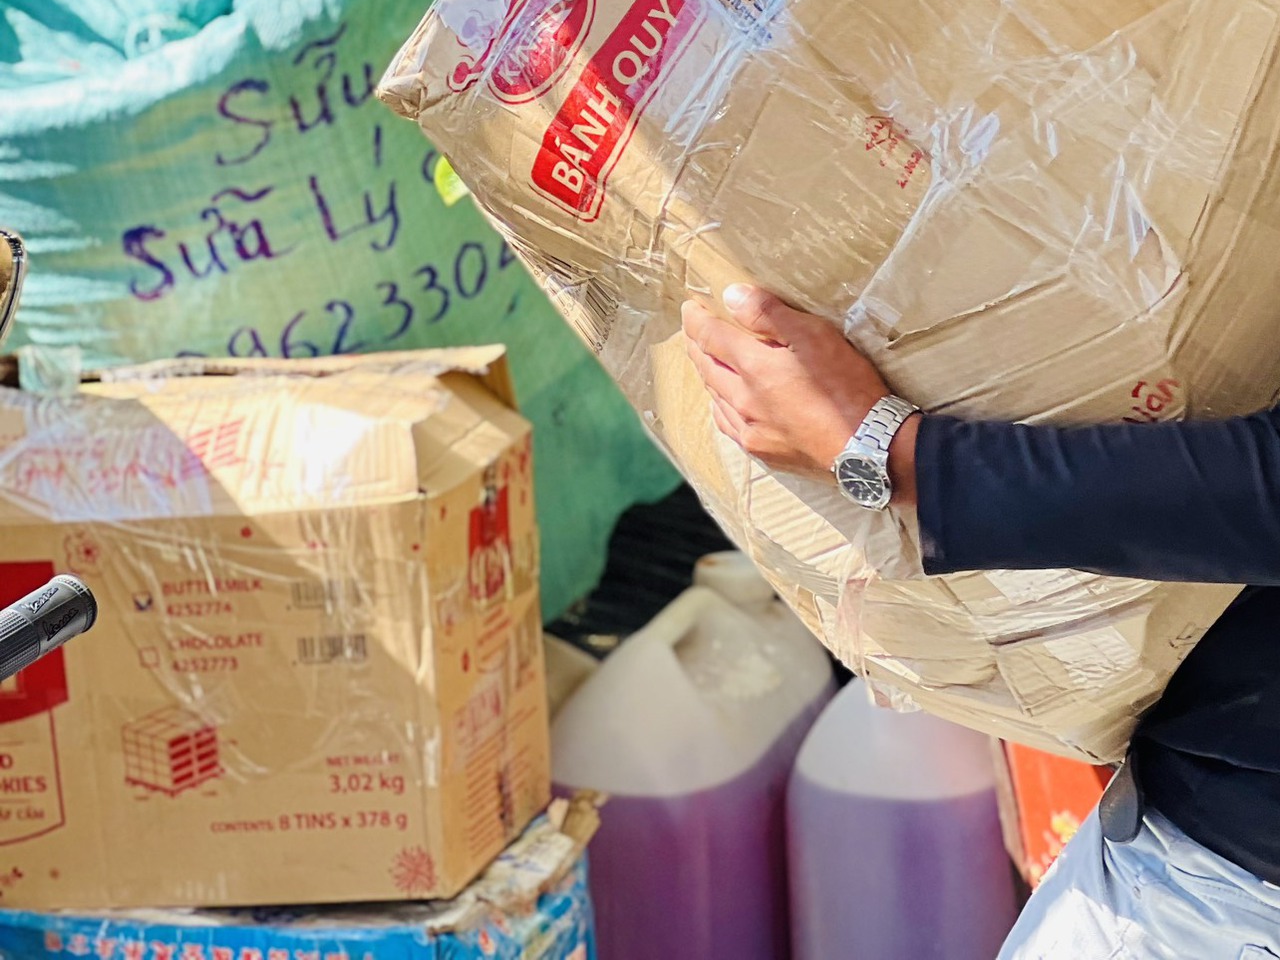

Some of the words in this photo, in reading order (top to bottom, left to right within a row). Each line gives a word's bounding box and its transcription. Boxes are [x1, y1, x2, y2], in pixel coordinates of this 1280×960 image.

[551, 82, 623, 194] BÁNH
[0, 776, 47, 793] KIES
[329, 774, 373, 794] 3,02
[379, 774, 405, 795] kg
[279, 814, 291, 831] 8
[294, 811, 337, 831] TINS
[357, 810, 392, 829] 378
